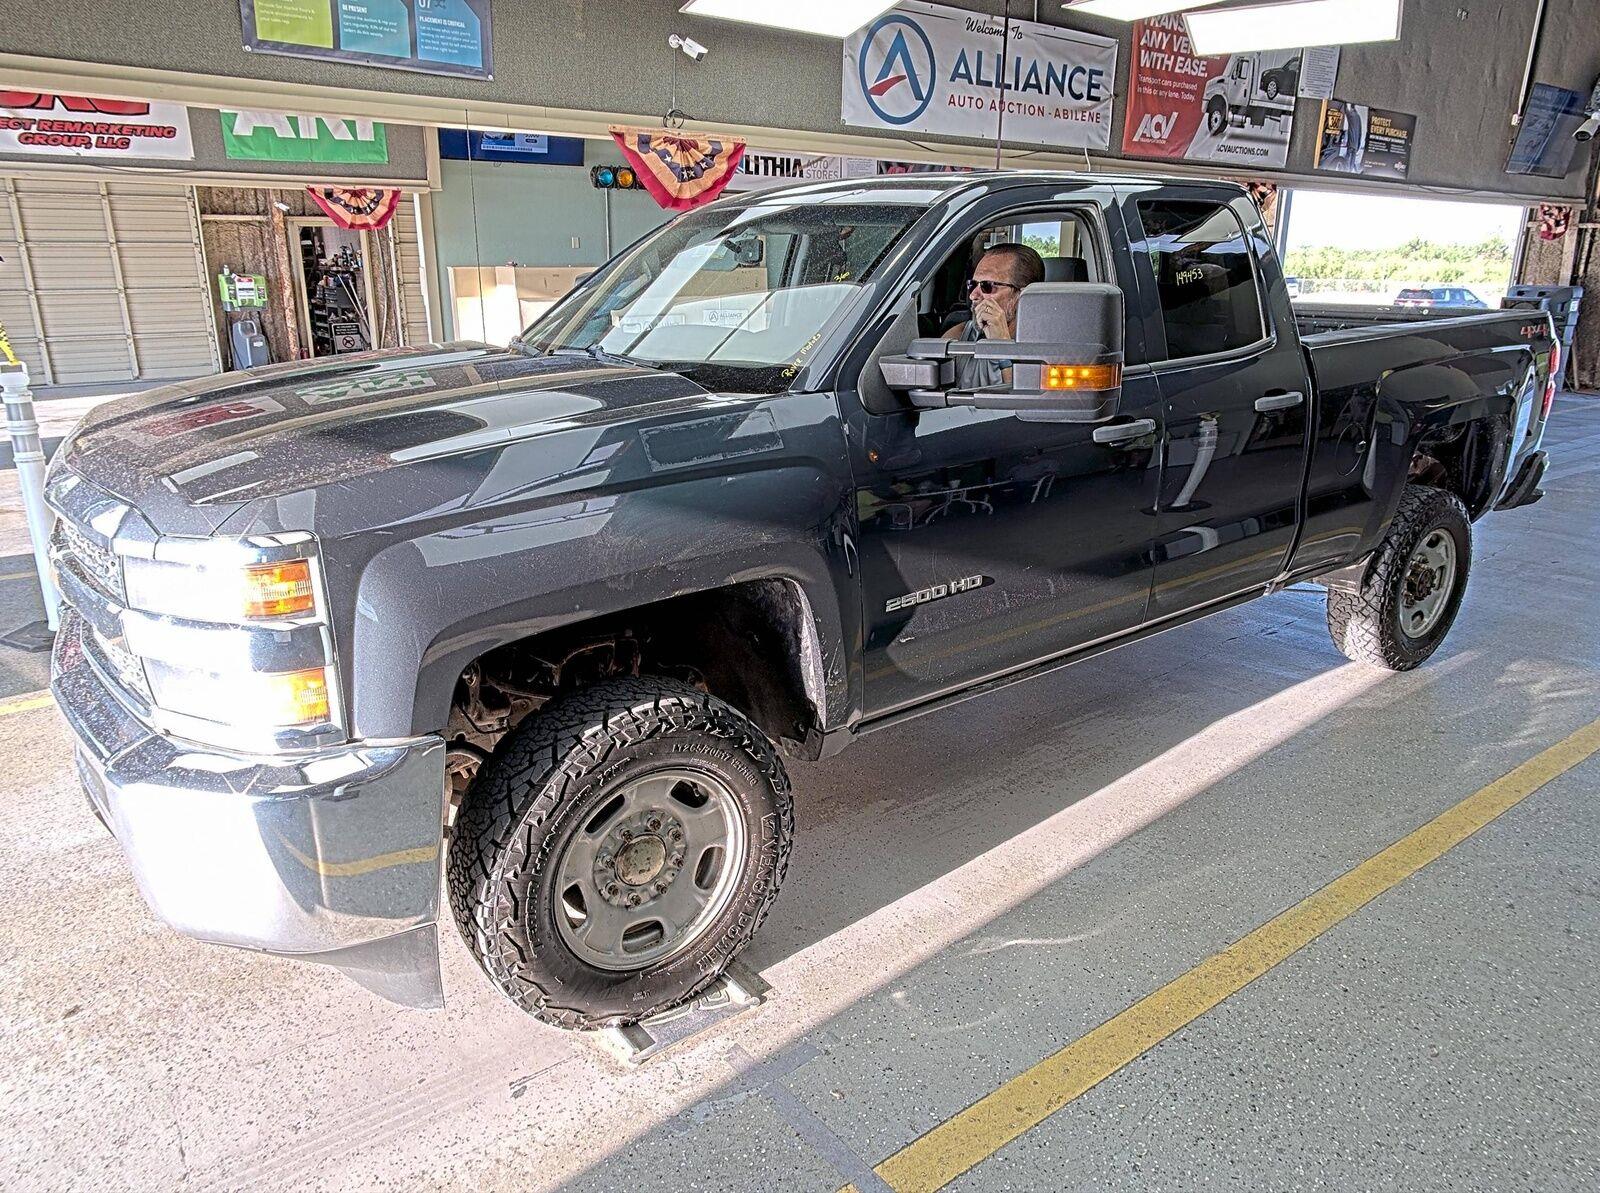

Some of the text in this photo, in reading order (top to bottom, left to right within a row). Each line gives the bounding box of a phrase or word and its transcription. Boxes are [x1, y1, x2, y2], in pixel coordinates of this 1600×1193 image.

[1012, 26, 1023, 40] To
[1140, 29, 1172, 50] ANY
[1140, 49, 1208, 78] WITH EASE.
[950, 48, 1104, 102] ALLIANCE
[1138, 74, 1198, 91] Transport cars purchased
[1142, 86, 1152, 95] this
[1159, 91, 1168, 99] any
[948, 94, 984, 110] AUTO
[989, 100, 1045, 117] AUCTION
[1054, 108, 1100, 124] ABILENE
[37, 118, 177, 138] REMARKETING
[1132, 112, 1179, 142] ACV
[1371, 116, 1392, 127] PROTECT
[18, 132, 131, 150] GROUP, LLC
[1370, 125, 1385, 135] EVERY
[1385, 128, 1408, 139] PURCHASE
[744, 154, 804, 178] LITHIA
[806, 158, 829, 170] AUTO
[804, 168, 838, 180] STORES
[1176, 268, 1204, 286] 149453
[886, 574, 983, 612] 2500 HD
[697, 838, 777, 972] VENOM POWER
